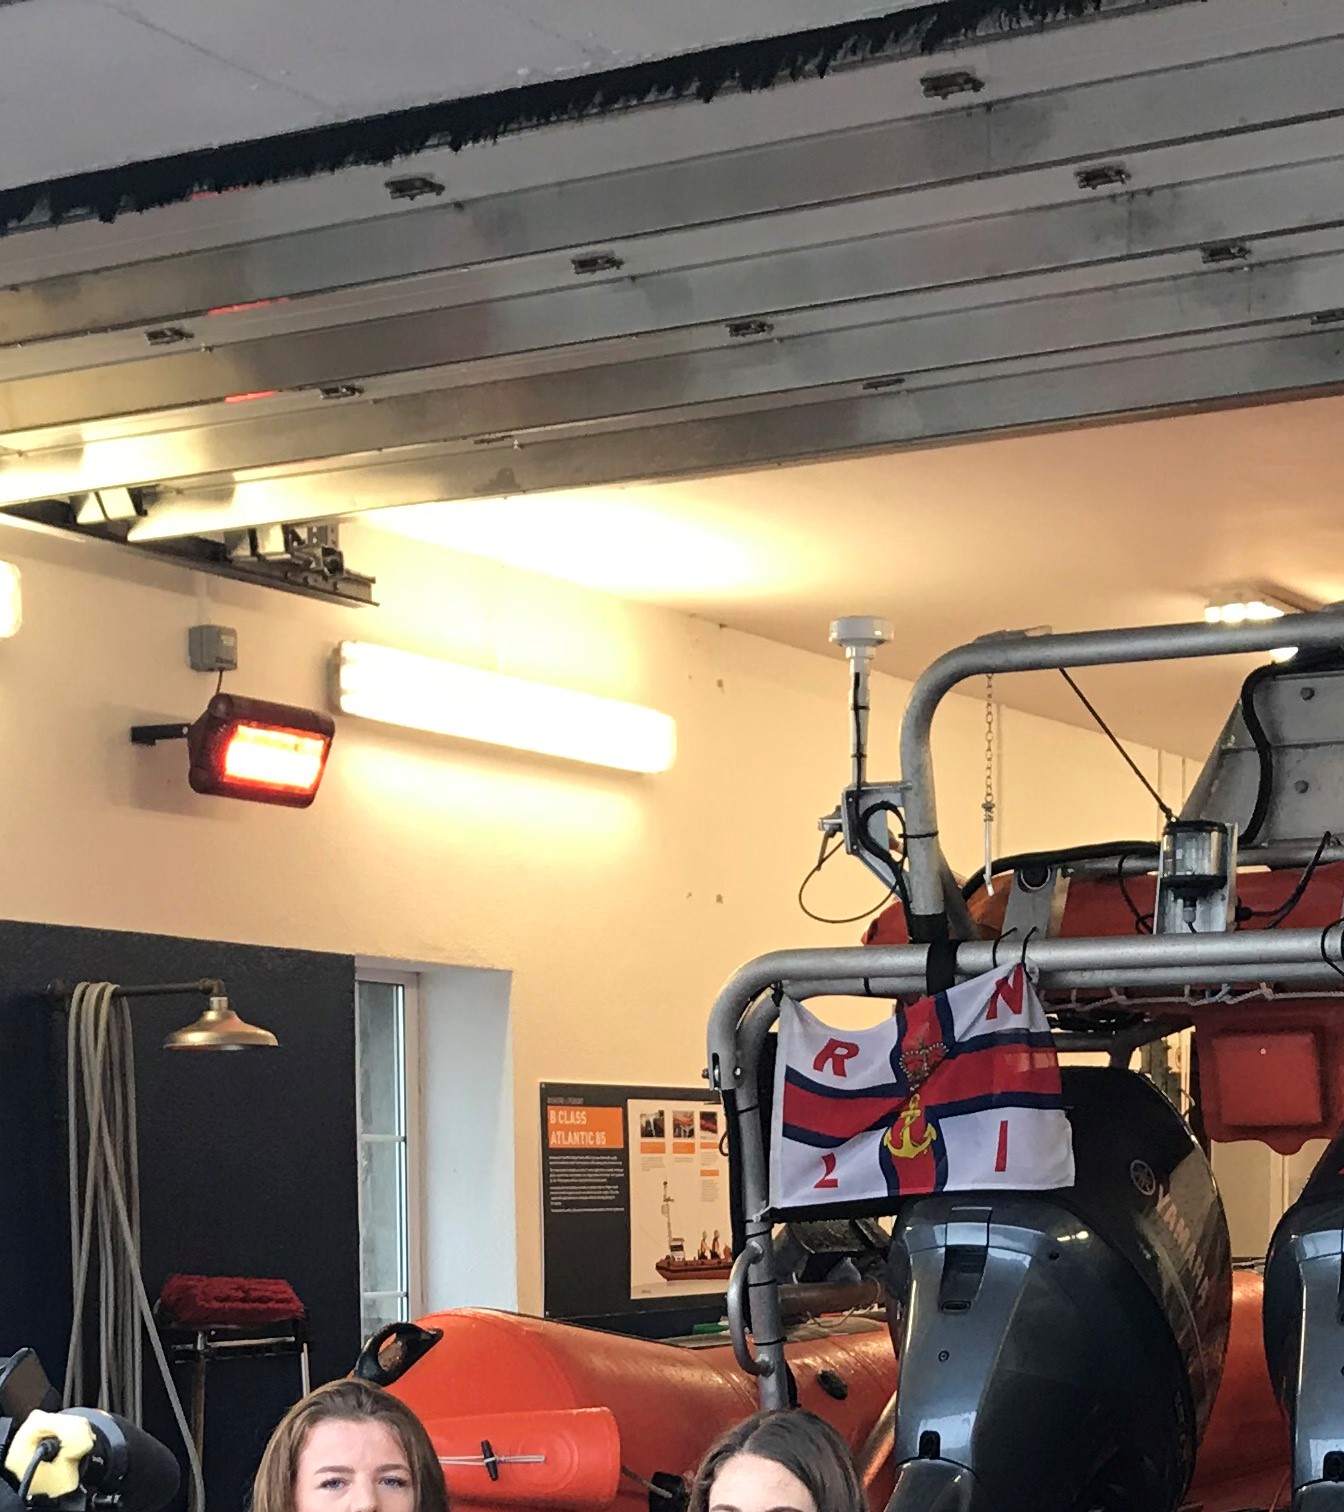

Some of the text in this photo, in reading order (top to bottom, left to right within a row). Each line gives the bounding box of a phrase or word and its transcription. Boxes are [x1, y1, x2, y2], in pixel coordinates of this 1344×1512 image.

[813, 963, 1024, 1078] R N
[549, 1110, 587, 1125] B CLASS
[550, 1131, 595, 1145] ATLANTIC
[1155, 1183, 1209, 1308] YAMAHA
